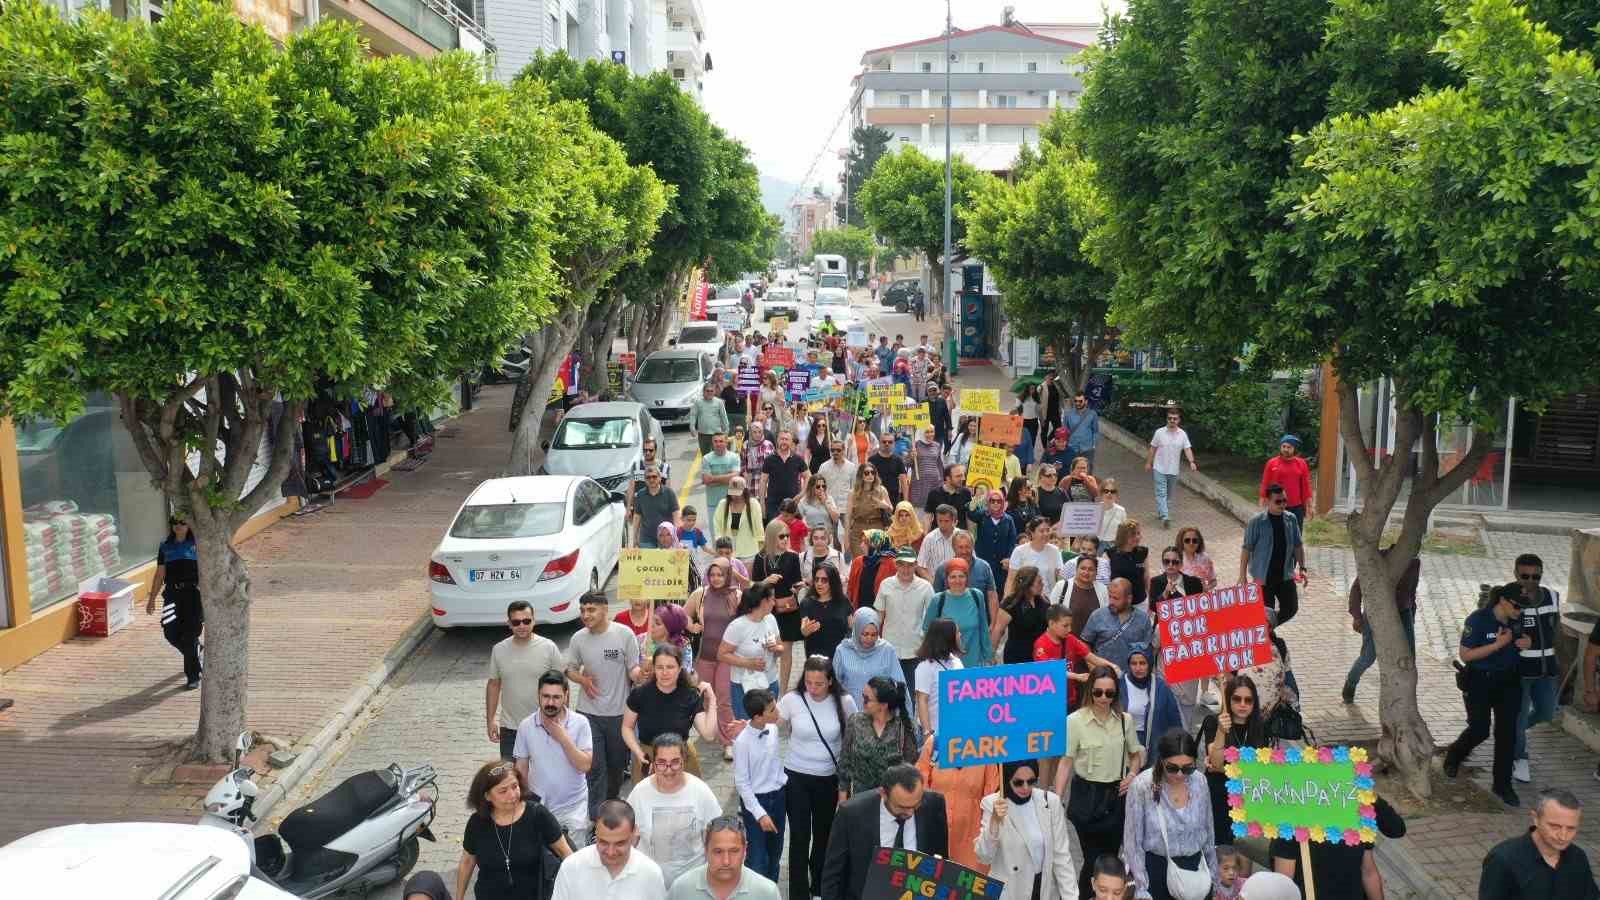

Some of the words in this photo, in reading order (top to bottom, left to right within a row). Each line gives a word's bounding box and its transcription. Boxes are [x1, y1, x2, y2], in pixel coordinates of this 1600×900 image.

[475, 570, 485, 581] 07
[1169, 616, 1206, 643] ÇOK
[1164, 626, 1266, 665] FARKIMIZ
[1215, 648, 1254, 673] YOK
[947, 674, 1057, 705] FARKINDA
[987, 702, 1017, 724] OL
[948, 736, 1008, 764] FARK
[1027, 731, 1055, 753] ET
